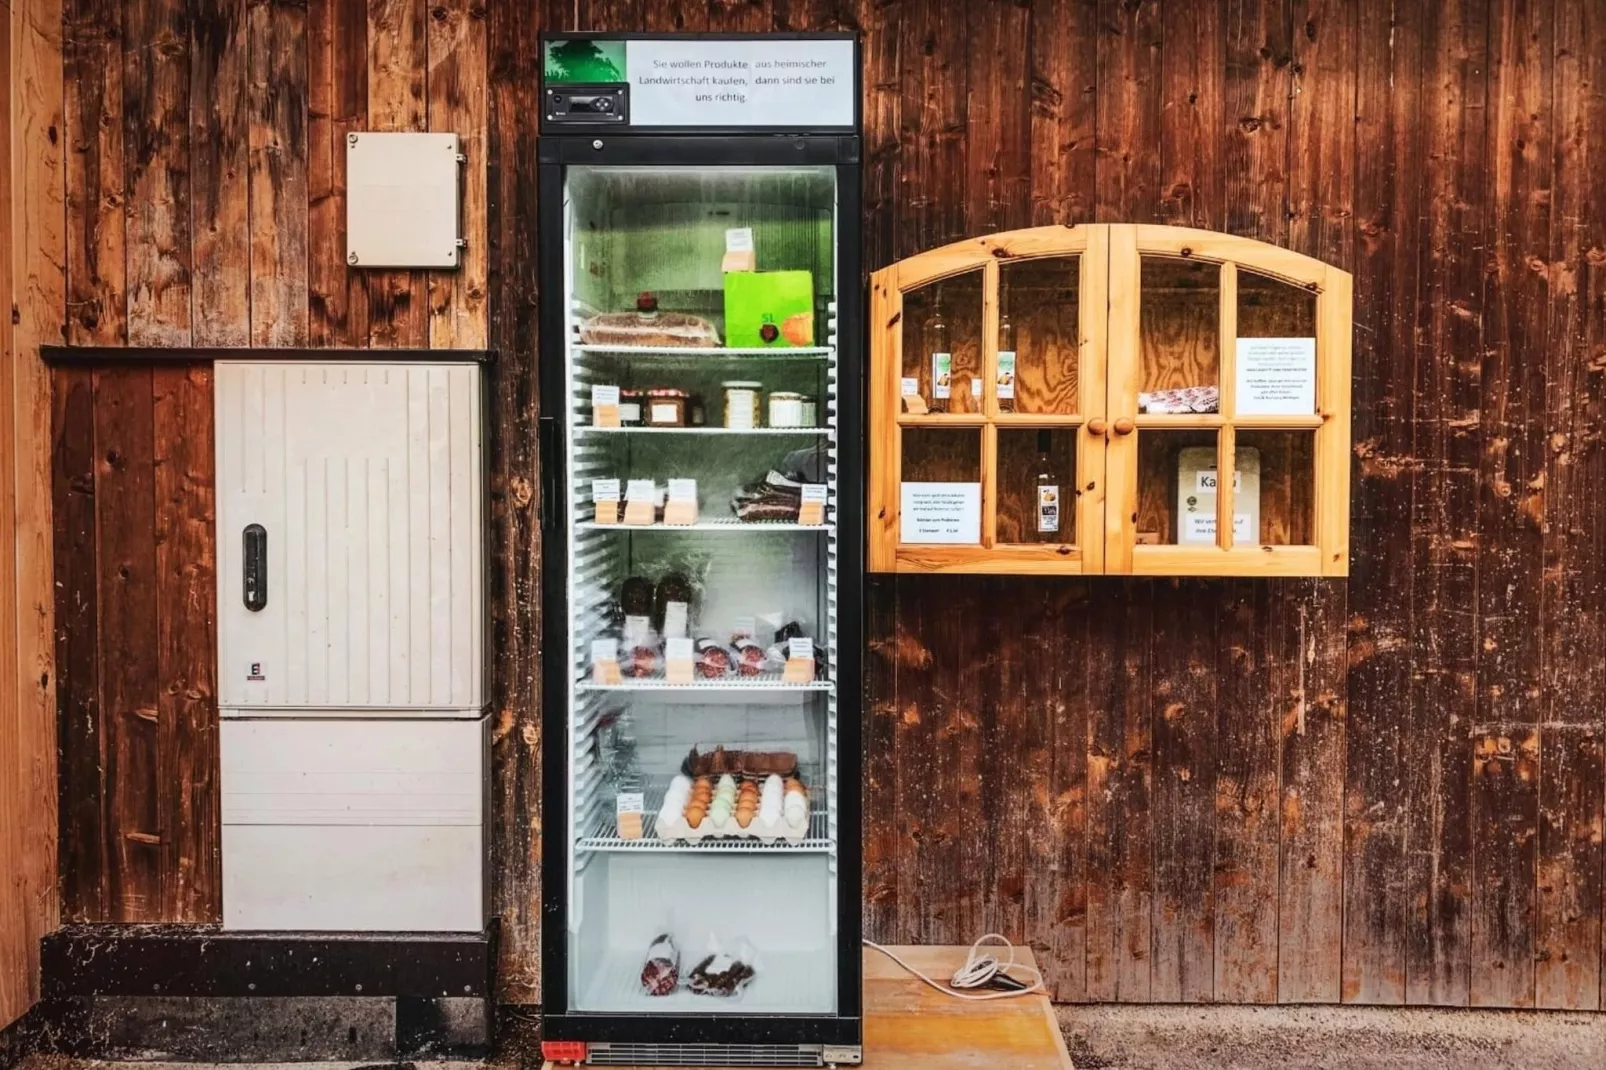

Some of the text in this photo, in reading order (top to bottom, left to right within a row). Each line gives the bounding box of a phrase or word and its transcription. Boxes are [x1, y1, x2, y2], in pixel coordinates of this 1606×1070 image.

[653, 59, 827, 69] Sie wollen Produkte aus heimischer
[639, 75, 835, 86] Landwirtschaft kaufen, dann sind sie bei
[695, 92, 748, 104] uns richtig.
